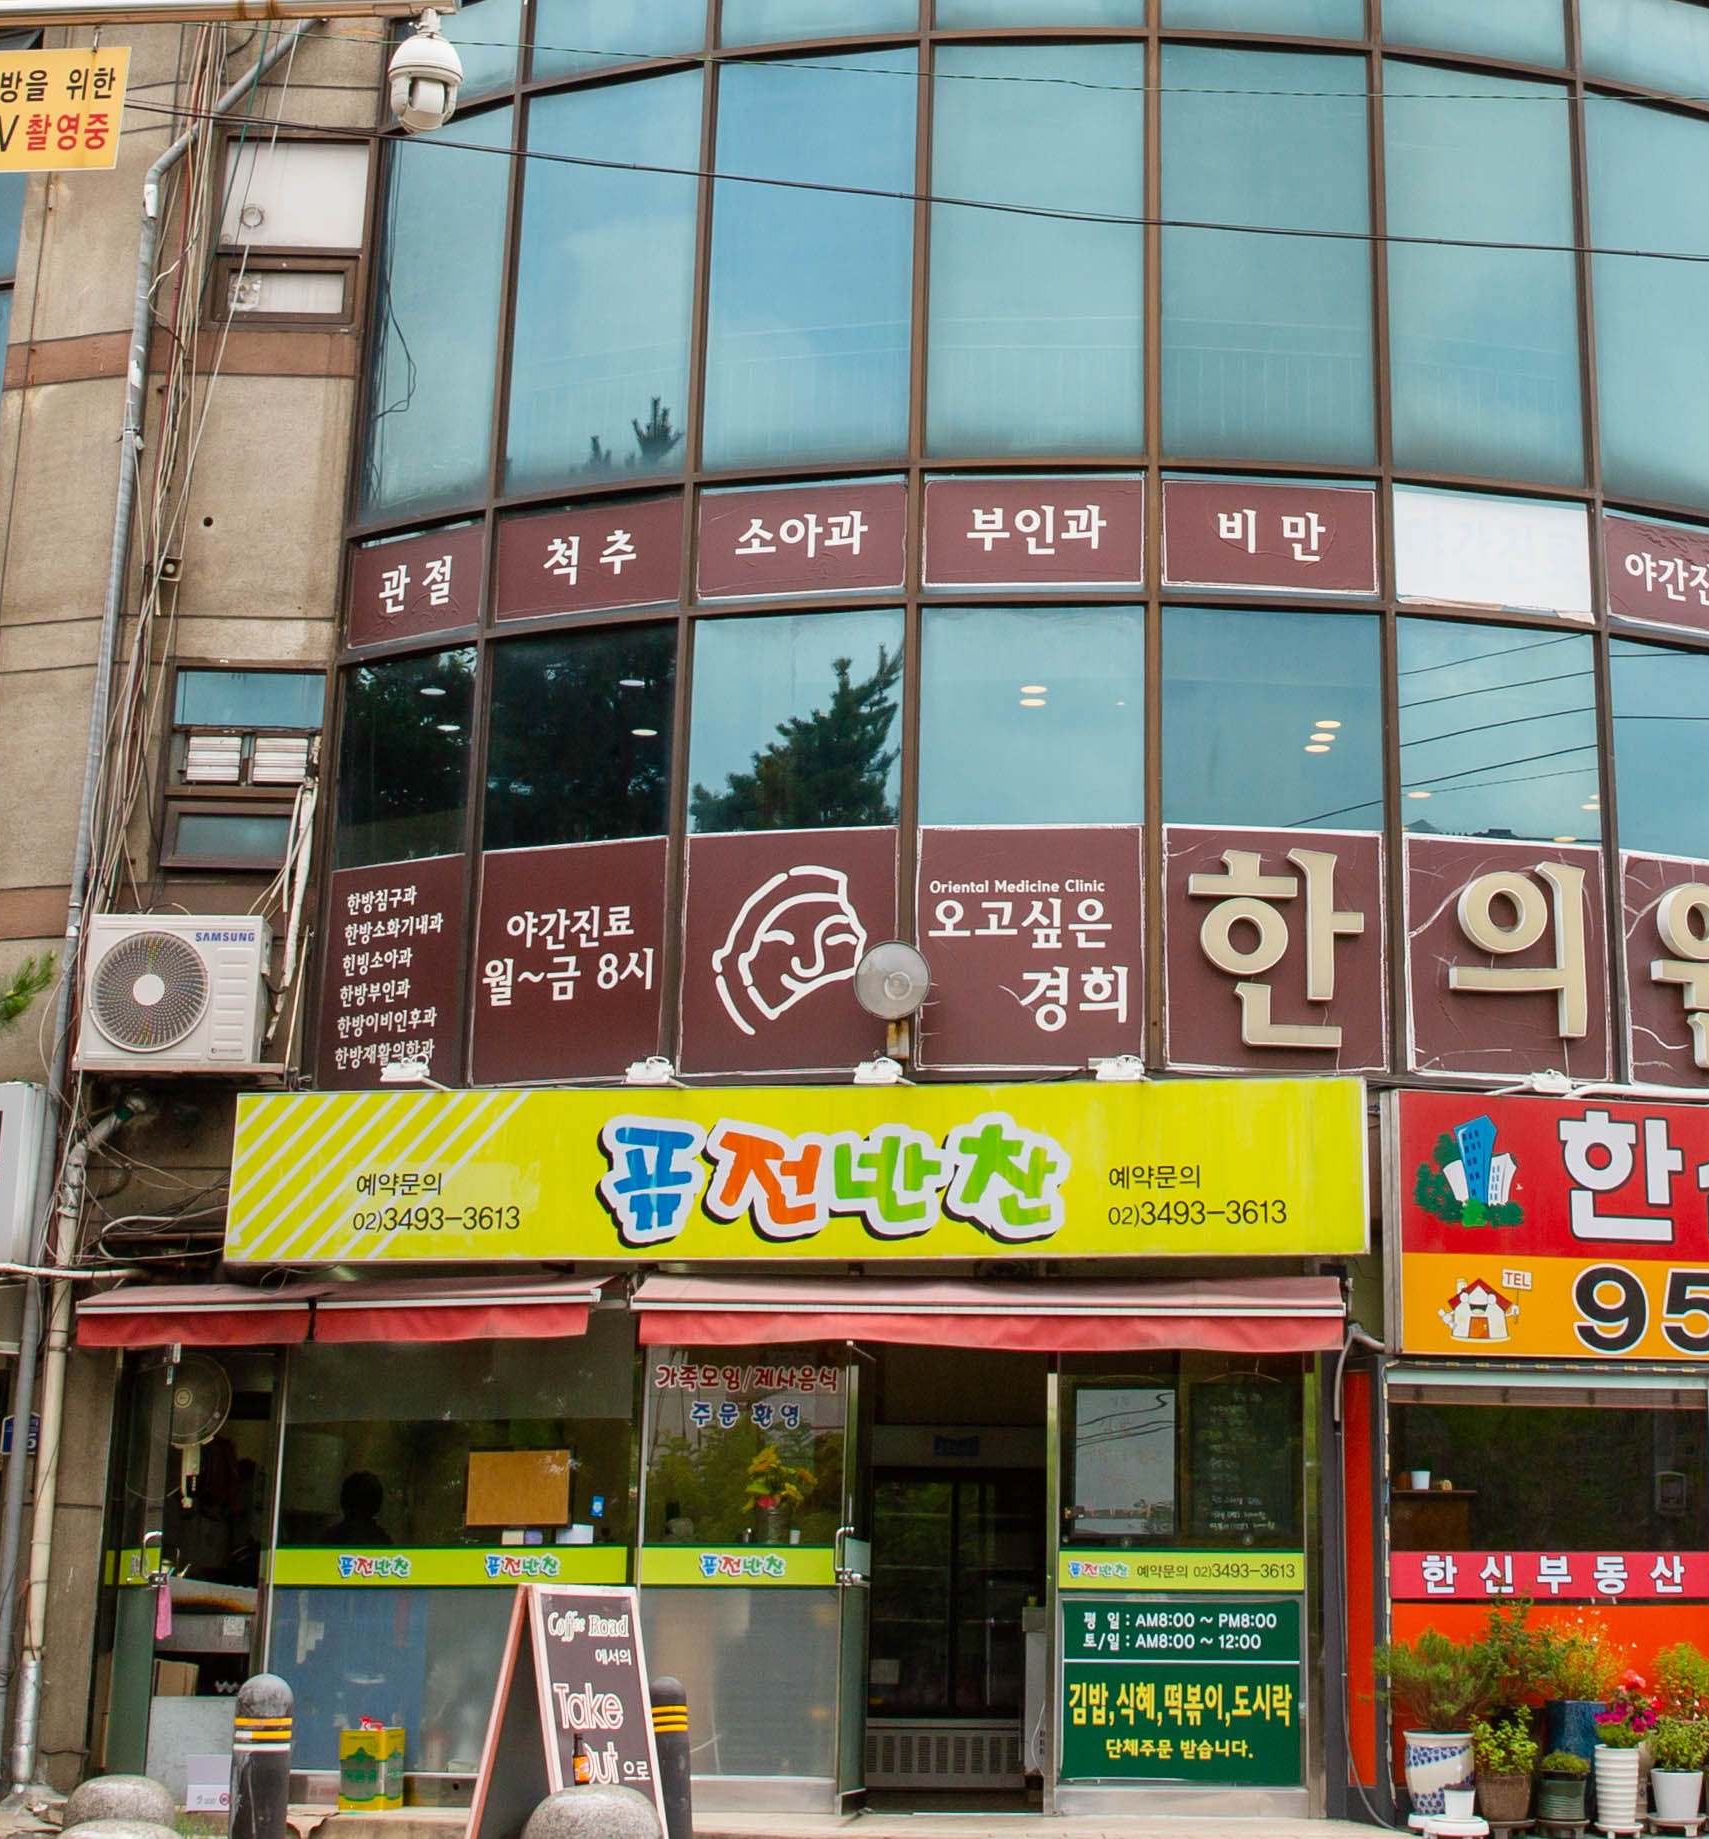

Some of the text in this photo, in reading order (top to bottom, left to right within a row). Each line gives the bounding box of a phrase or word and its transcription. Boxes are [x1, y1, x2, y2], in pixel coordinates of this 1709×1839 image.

[66, 66, 116, 100] 위한
[25, 112, 110, 151] 촬영중
[735, 510, 869, 559] 소아과
[967, 504, 1108, 556] 부인과
[346, 885, 417, 916] 한방침구과
[929, 878, 1106, 894] Oriental Medicine Clinic
[195, 931, 255, 943] SAMSUNG
[344, 912, 444, 946] 한방소화기내과
[506, 905, 635, 950] 야간진료
[928, 898, 1114, 950] 오고싶은
[597, 946, 655, 992] 8시
[340, 978, 411, 1008] 한방부인과
[1020, 964, 1130, 1033] 경희
[337, 1006, 437, 1039] 한방이비인후과
[356, 1171, 442, 1198] 예약문의
[1108, 1163, 1201, 1190] 예약문의
[352, 1205, 521, 1234] 02)3493-3613
[1107, 1198, 1288, 1228] 02)3493-3613
[1504, 1271, 1531, 1288] TEL
[1136, 1564, 1188, 1579] 예약문의
[1193, 1563, 1296, 1579] 02)3493-3613
[547, 1611, 630, 1642] Coffee Road
[1135, 1612, 1195, 1628] AM8:00
[1218, 1612, 1277, 1628] PM8:00
[1135, 1633, 1195, 1649] AM8:00
[1218, 1633, 1262, 1650] 12:00
[553, 1682, 624, 1730] Take
[1105, 1738, 1254, 1760] 단체주문 받습니다.
[623, 1760, 651, 1781] 으로
